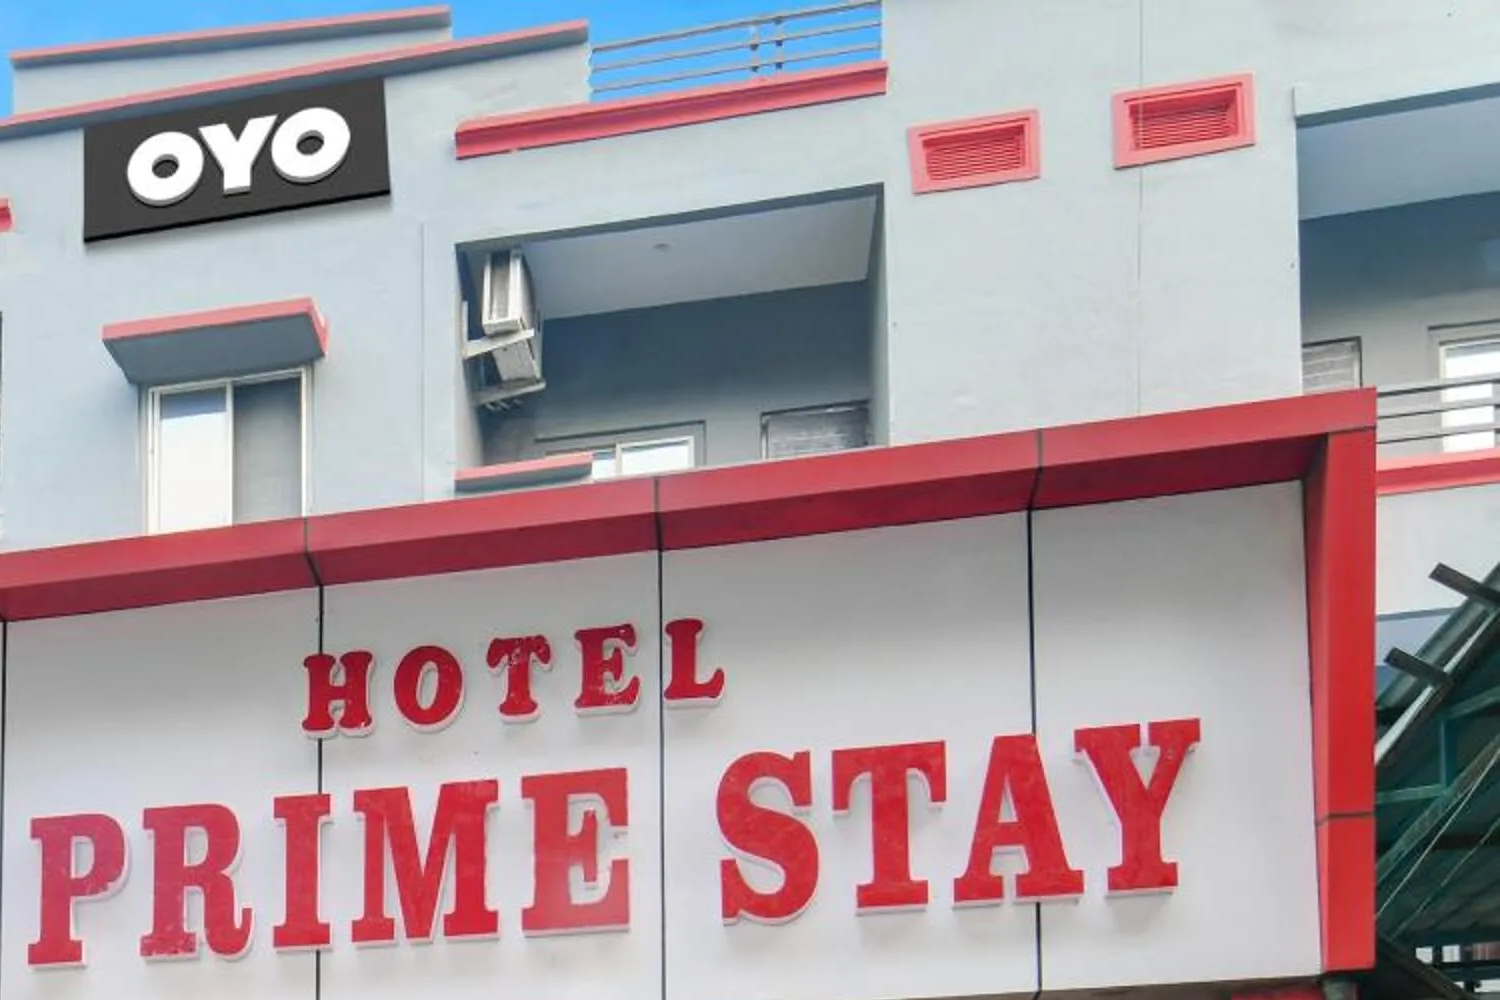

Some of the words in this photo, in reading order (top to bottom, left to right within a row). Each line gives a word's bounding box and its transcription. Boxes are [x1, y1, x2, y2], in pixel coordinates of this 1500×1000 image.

[127, 106, 351, 207] OYO
[301, 617, 725, 737] HOTEL
[27, 768, 631, 968] PRIME
[716, 717, 1201, 926] STAY
